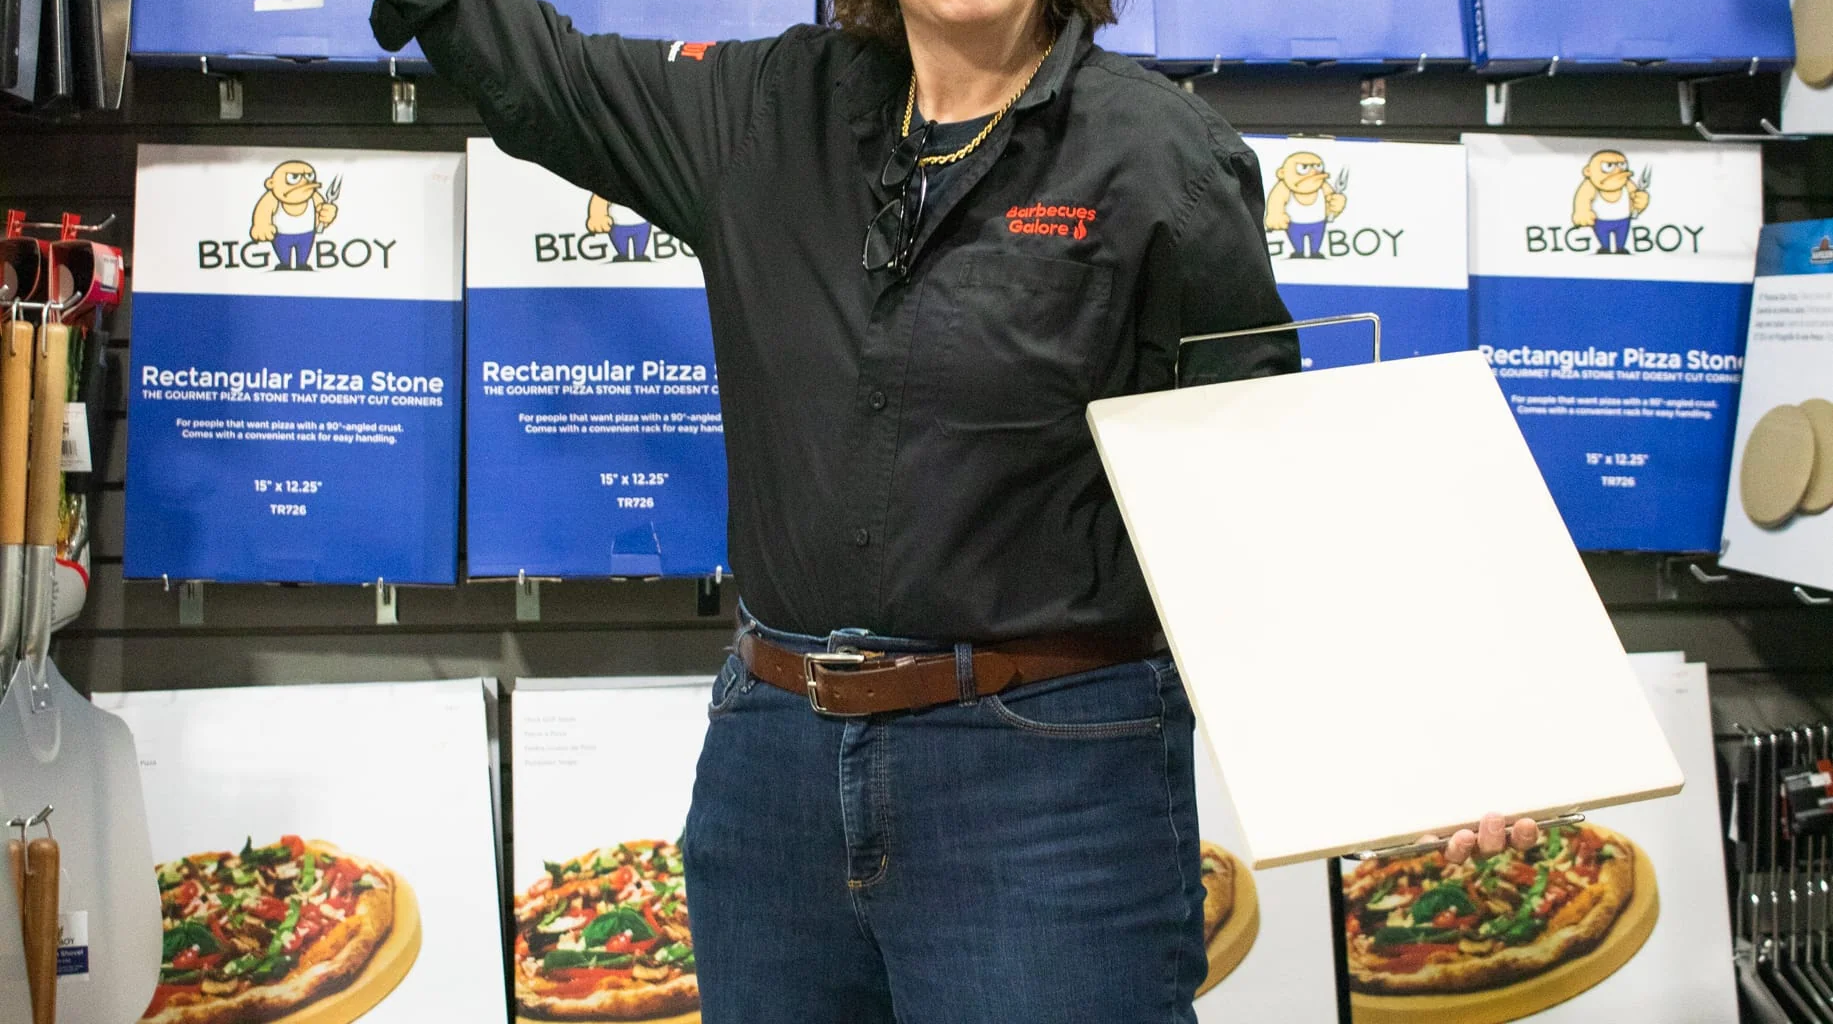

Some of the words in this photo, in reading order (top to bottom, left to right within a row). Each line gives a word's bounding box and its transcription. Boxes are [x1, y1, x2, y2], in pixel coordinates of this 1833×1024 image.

[1005, 202, 1097, 222] Barbecues
[1008, 219, 1069, 236] Galore
[1328, 227, 1404, 257] BOY
[1526, 225, 1591, 253] BIG
[1631, 225, 1704, 253] BOY
[199, 240, 271, 269] BIG
[315, 238, 397, 269] BOY
[535, 233, 608, 262] BIG
[1478, 344, 1618, 369] Rectangular
[1623, 347, 1682, 369] Pizza
[142, 365, 293, 393] Rectangular
[300, 368, 363, 391] Pizza
[371, 371, 444, 393] Stone
[482, 359, 635, 386] Rectangular
[642, 359, 706, 381] Pizza
[1582, 370, 1615, 380] STONE
[1616, 370, 1640, 380] THAT
[1685, 372, 1704, 382] CUT
[1705, 373, 1742, 384] CORNE
[484, 385, 504, 395] THE
[506, 385, 560, 395] GOURMET
[562, 385, 594, 395] PIZZA
[595, 385, 632, 395] STONE
[634, 384, 661, 395] THAT
[663, 384, 709, 395] DOESN'T
[142, 389, 163, 401] THE
[164, 389, 219, 402] GOURMET
[220, 391, 251, 403] PIZZA
[252, 391, 289, 403] STONE
[291, 392, 318, 404] THAT
[320, 393, 366, 405] DOESN'T
[367, 395, 389, 406] CUT
[391, 395, 443, 407] CORNERS
[176, 418, 191, 427] For
[193, 418, 224, 429] people
[226, 419, 245, 429] that
[246, 420, 270, 429] want
[271, 420, 295, 431] pizza
[296, 421, 317, 431] with
[318, 423, 325, 431] a
[378, 423, 404, 433] crust.
[519, 413, 534, 422] For
[535, 413, 568, 424] people
[569, 413, 589, 422] that
[590, 413, 613, 422] want
[615, 413, 640, 424] pizza
[641, 413, 661, 422] with
[182, 429, 213, 439] Comes
[215, 429, 235, 439] with
[245, 431, 295, 441] convenient
[296, 432, 316, 442] rack
[318, 432, 331, 442] for
[333, 434, 354, 444] easy
[355, 433, 397, 445] handling.
[525, 424, 557, 433] Comes
[559, 424, 580, 433] with
[588, 424, 639, 433] convenient
[641, 424, 661, 433] rack
[662, 424, 676, 433] for
[677, 426, 699, 435] easy
[1585, 452, 1603, 465] 15"
[1605, 455, 1613, 465] x
[1614, 453, 1649, 466] 12.25"
[254, 479, 272, 492] 15"
[274, 482, 283, 492] x
[285, 480, 323, 493] 12.25"
[600, 473, 618, 485] 15"
[621, 475, 629, 485] x
[632, 473, 669, 486] 12.25"
[270, 503, 307, 516] TR726
[617, 497, 655, 508] TR726
